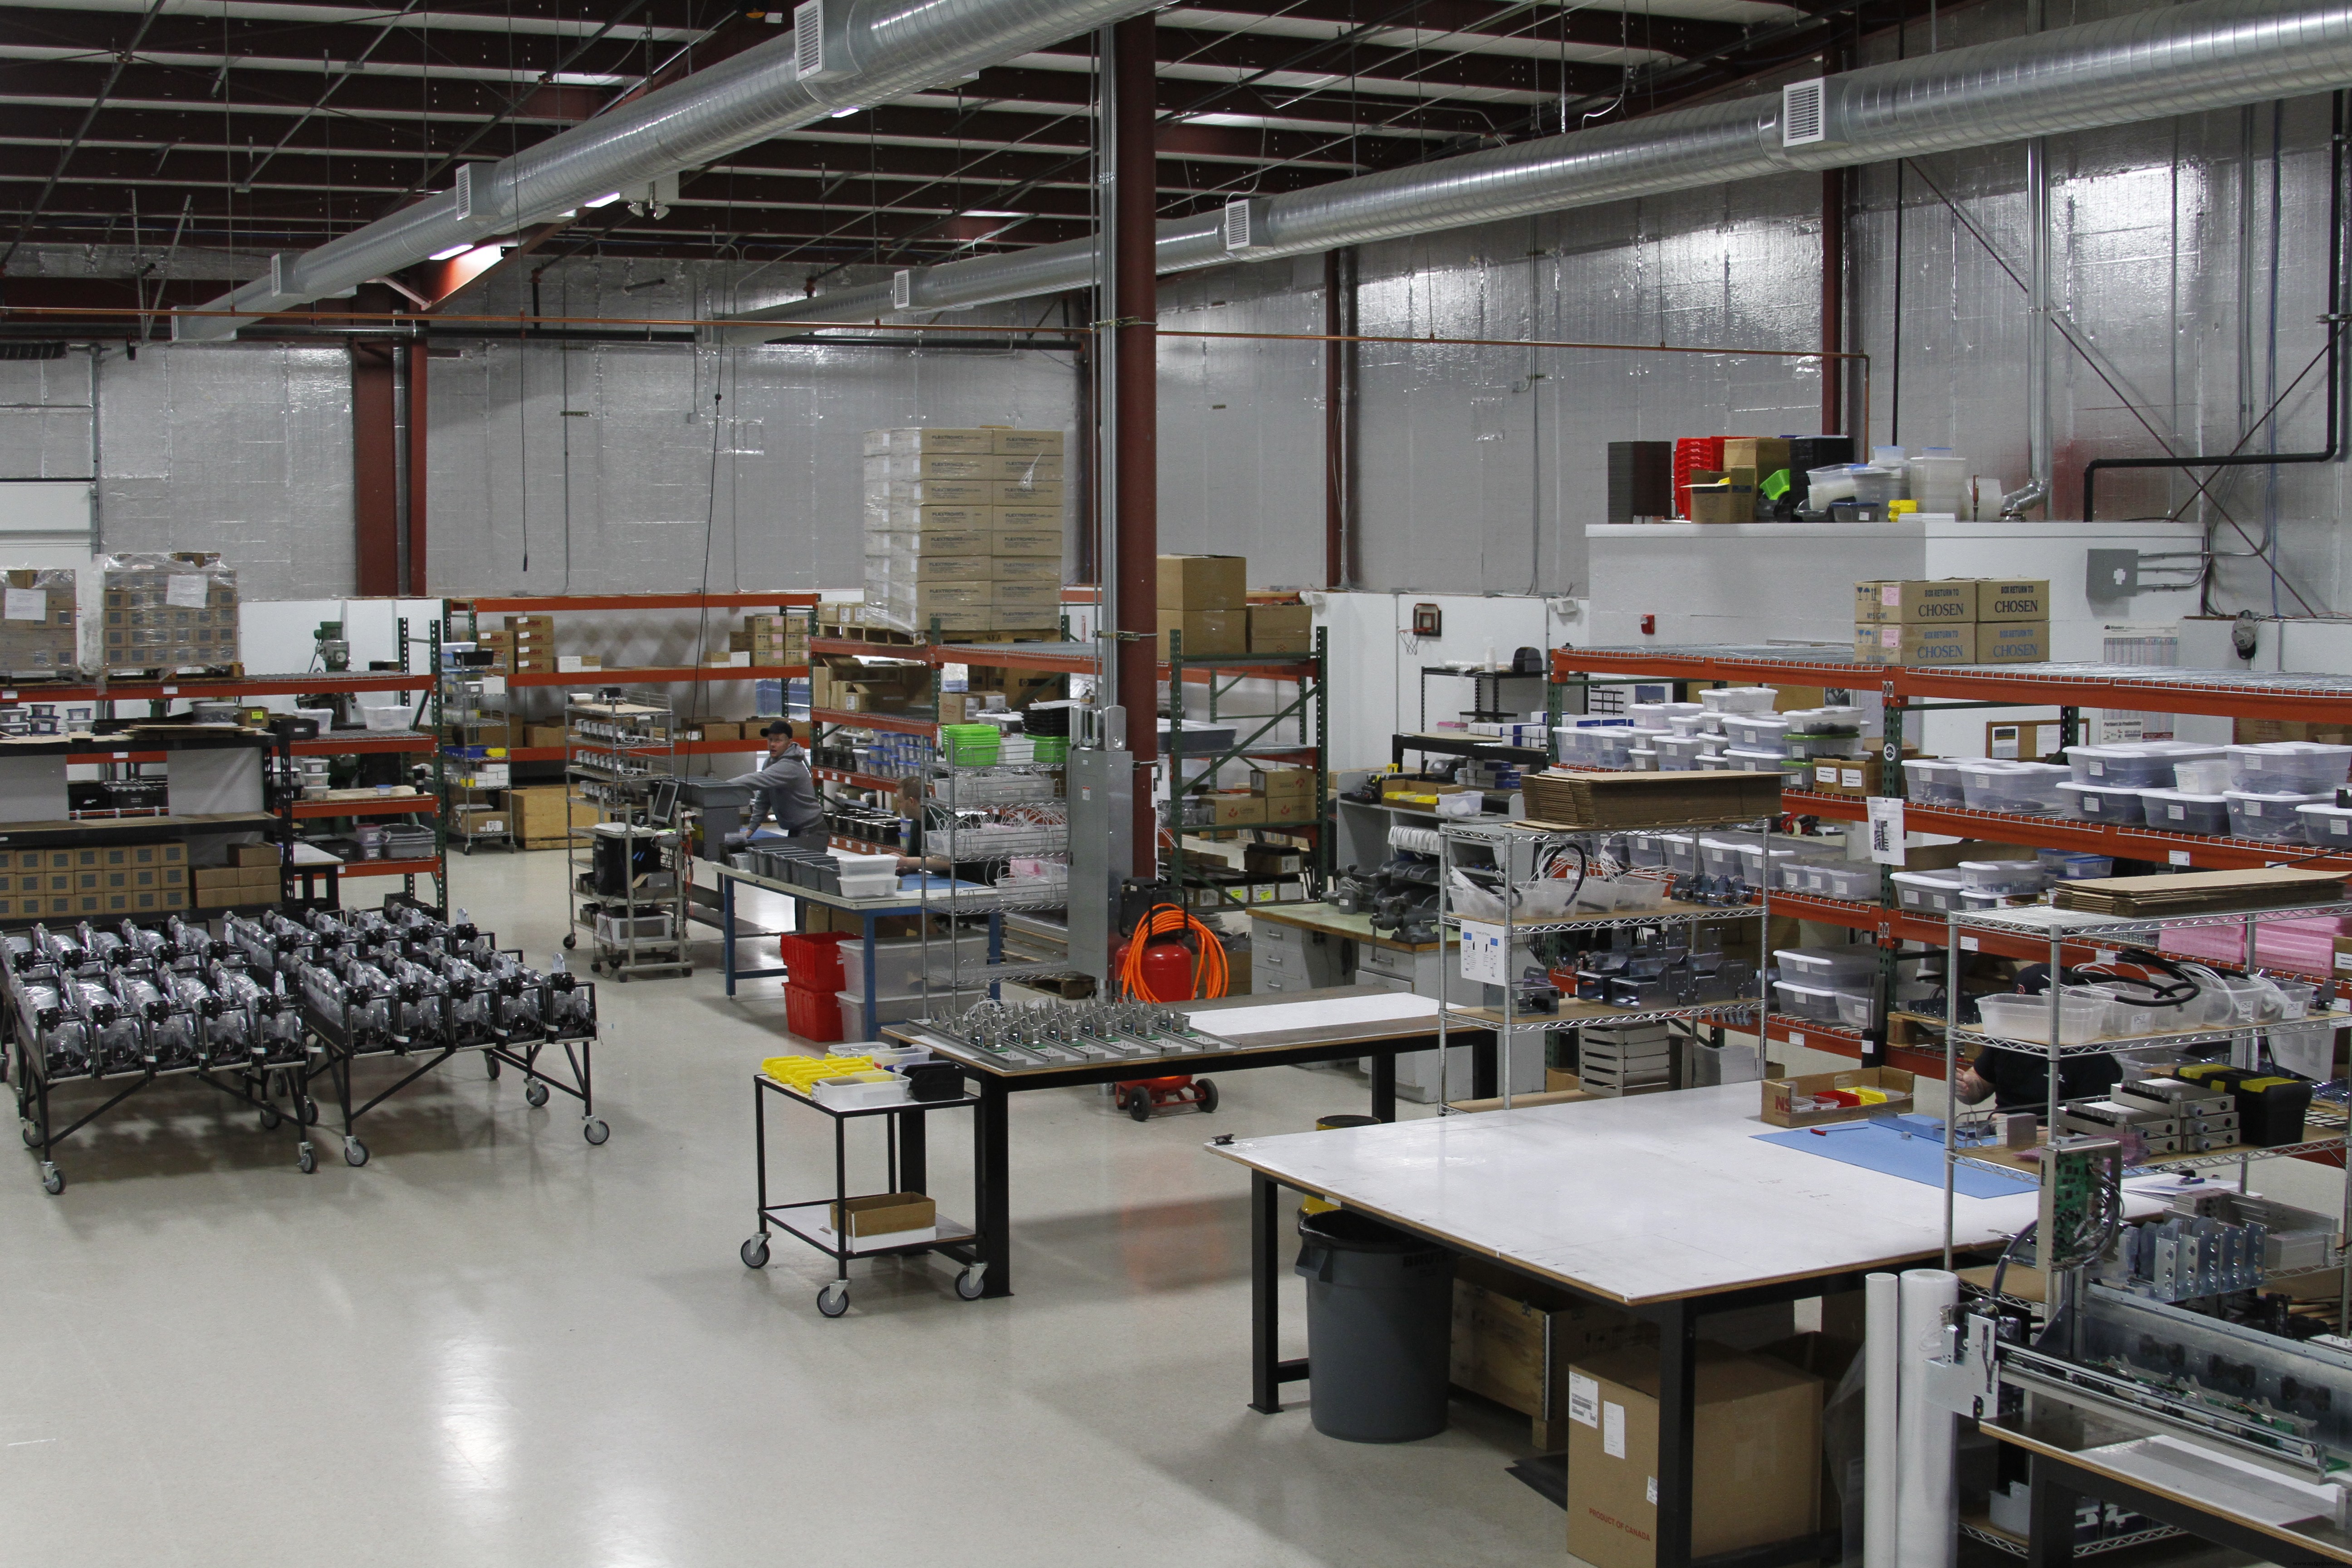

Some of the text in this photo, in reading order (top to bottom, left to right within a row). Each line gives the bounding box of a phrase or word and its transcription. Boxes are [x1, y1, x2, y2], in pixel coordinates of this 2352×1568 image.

[1918, 603, 1964, 617] CHOSEN
[1994, 600, 2038, 613] CHOSEN
[1917, 645, 1963, 658] CHOSEN
[1993, 643, 2038, 657] CHOSEN
[1589, 1507, 1650, 1542] PRODUCT OF CANADA
